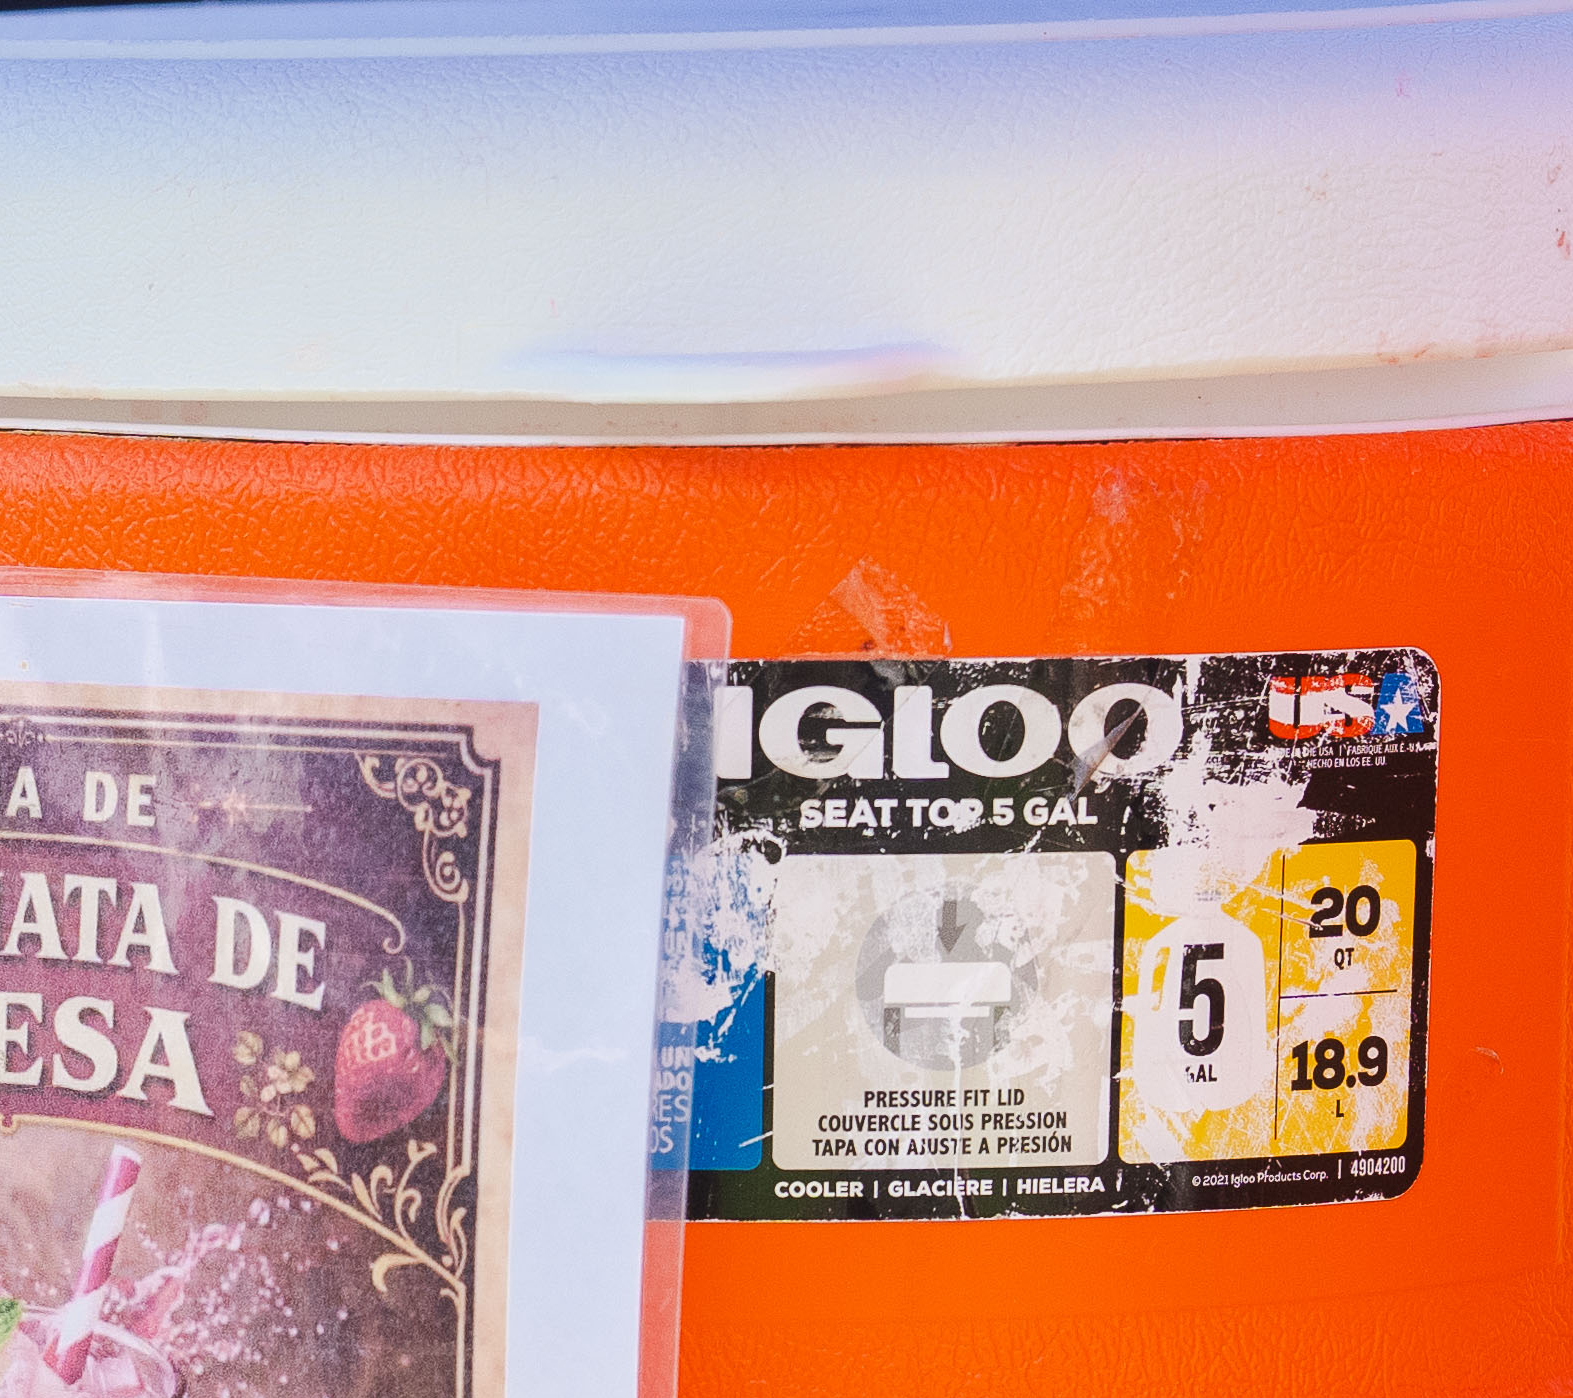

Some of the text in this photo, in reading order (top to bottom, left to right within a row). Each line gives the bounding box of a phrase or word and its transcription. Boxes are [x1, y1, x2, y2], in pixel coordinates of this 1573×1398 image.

[1269, 673, 1425, 739] USA
[714, 683, 1184, 779] IGLOO
[1346, 757, 1361, 767] LOS
[83, 771, 159, 828] DE
[799, 797, 1098, 828] SEAT TOP 5 GAL
[1309, 885, 1381, 939] 20
[207, 894, 328, 1012] DE
[1334, 947, 1354, 970] QT
[1178, 943, 1225, 1057] 5
[1291, 1035, 1388, 1091] 18.9
[864, 1088, 1025, 1108] PRESSURE FIT LID
[1335, 1099, 1344, 1117] L
[818, 1111, 1067, 1132] COUVERCLE SOUS PRESSION
[812, 1131, 1072, 1157] TAPA CON AJUSTE A PRESIÓN
[1350, 1156, 1406, 1177] 4904200
[774, 1180, 864, 1199] COOLER
[887, 1176, 993, 1198] GLACIÈRE
[1017, 1176, 1105, 1195] HIELERA
[1203, 1175, 1229, 1186] 2021
[1231, 1174, 1256, 1188] Igloo
[1257, 1171, 1302, 1183] Products
[1303, 1169, 1329, 1182] Corp.
